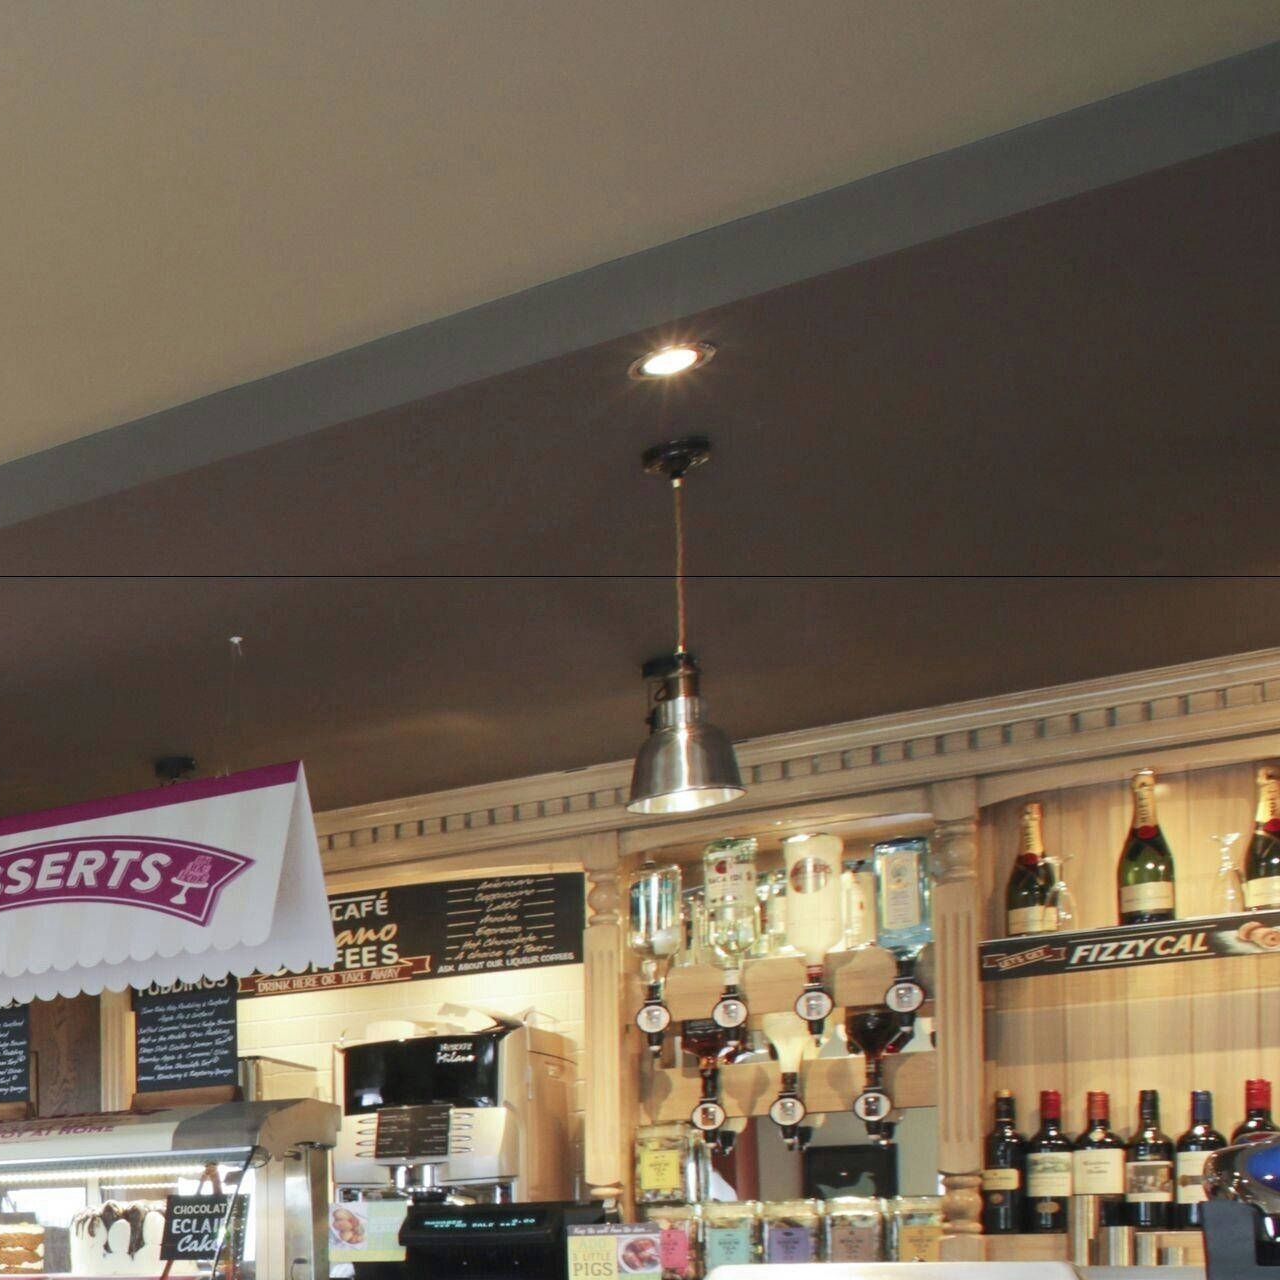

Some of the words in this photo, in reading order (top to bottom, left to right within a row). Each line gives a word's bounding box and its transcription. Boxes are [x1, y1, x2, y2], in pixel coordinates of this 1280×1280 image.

[1070, 932, 1209, 964] FIZZYCAL
[437, 965, 455, 974] ASK
[458, 961, 485, 971] ABOUT
[486, 959, 503, 968] OUR
[505, 955, 539, 967] LIQUEUR
[541, 952, 575, 962] COFFEES
[258, 979, 290, 992] DRINK
[292, 976, 318, 989] HERE
[321, 974, 336, 986] OR
[341, 970, 366, 983] TAKE
[370, 967, 401, 981] AWAY
[59, 1124, 114, 1134] HOME
[177, 1234, 226, 1252] Cake
[573, 1262, 613, 1277] PIGS
